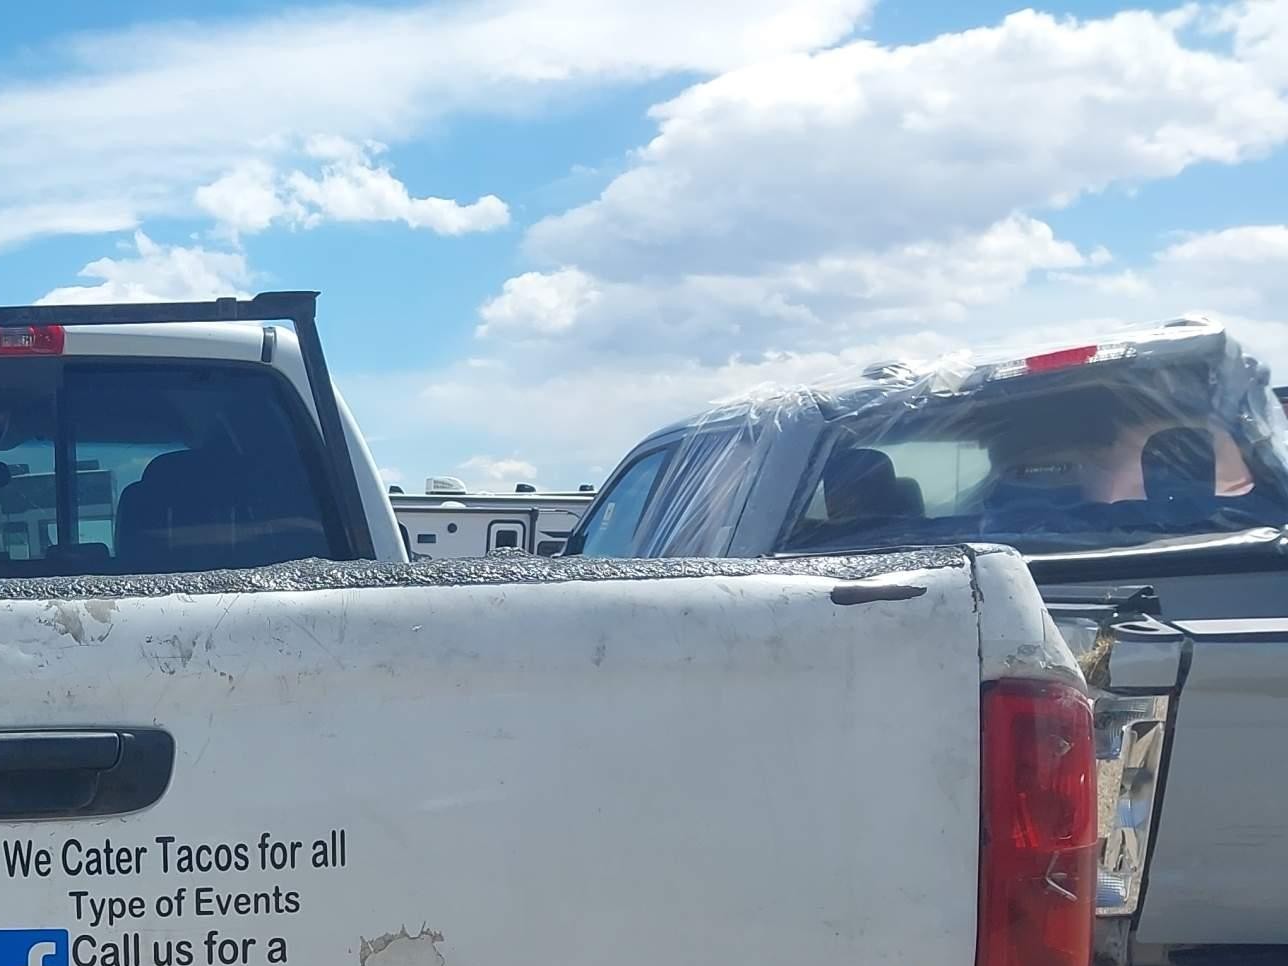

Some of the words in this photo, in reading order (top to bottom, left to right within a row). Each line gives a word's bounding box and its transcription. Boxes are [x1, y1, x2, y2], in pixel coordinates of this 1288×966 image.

[3, 839, 53, 878] We
[61, 838, 148, 877] Cater
[155, 835, 250, 874] Tacos
[257, 832, 303, 871] for
[311, 829, 347, 868] all
[68, 890, 146, 928] Type
[155, 886, 187, 918] of
[195, 885, 301, 916] Events
[152, 939, 194, 966] us
[204, 930, 256, 966] for
[267, 936, 288, 964] a
